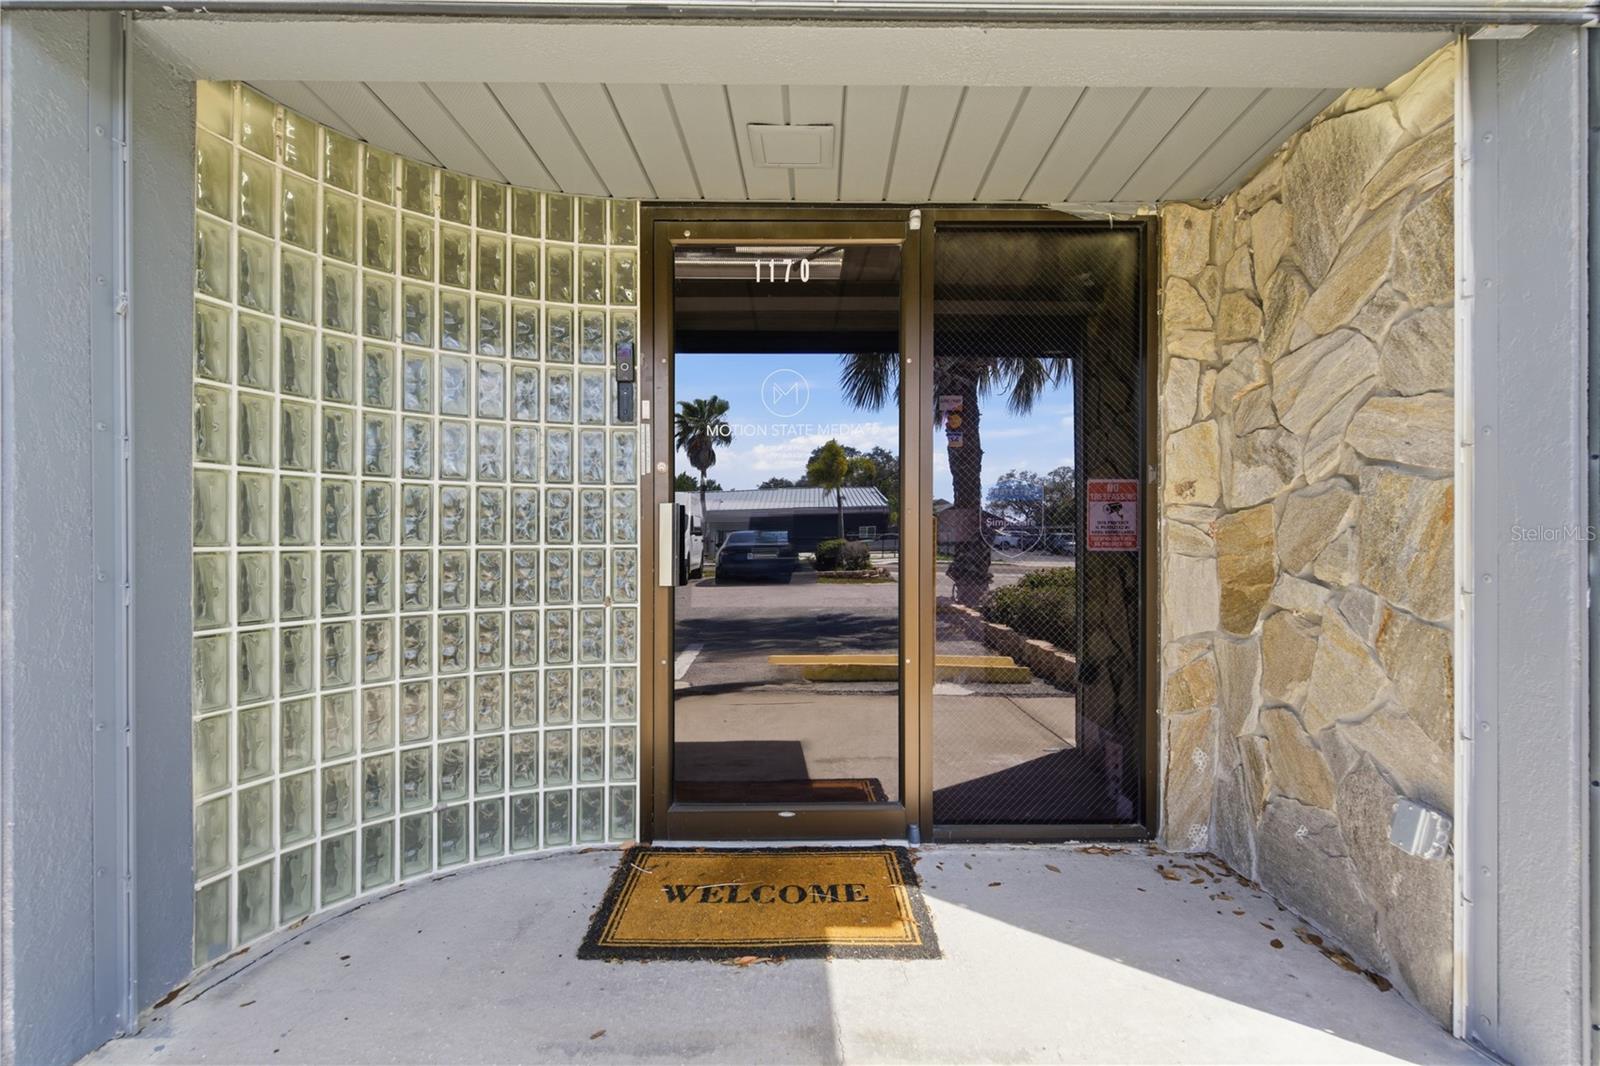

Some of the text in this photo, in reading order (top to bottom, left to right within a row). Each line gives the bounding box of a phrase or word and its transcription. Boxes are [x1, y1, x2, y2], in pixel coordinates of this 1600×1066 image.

[754, 258, 811, 283] 1170
[705, 423, 865, 437] MOTION STATE MEDIA
[1106, 483, 1120, 493] NO
[661, 883, 870, 904] WELCOME
